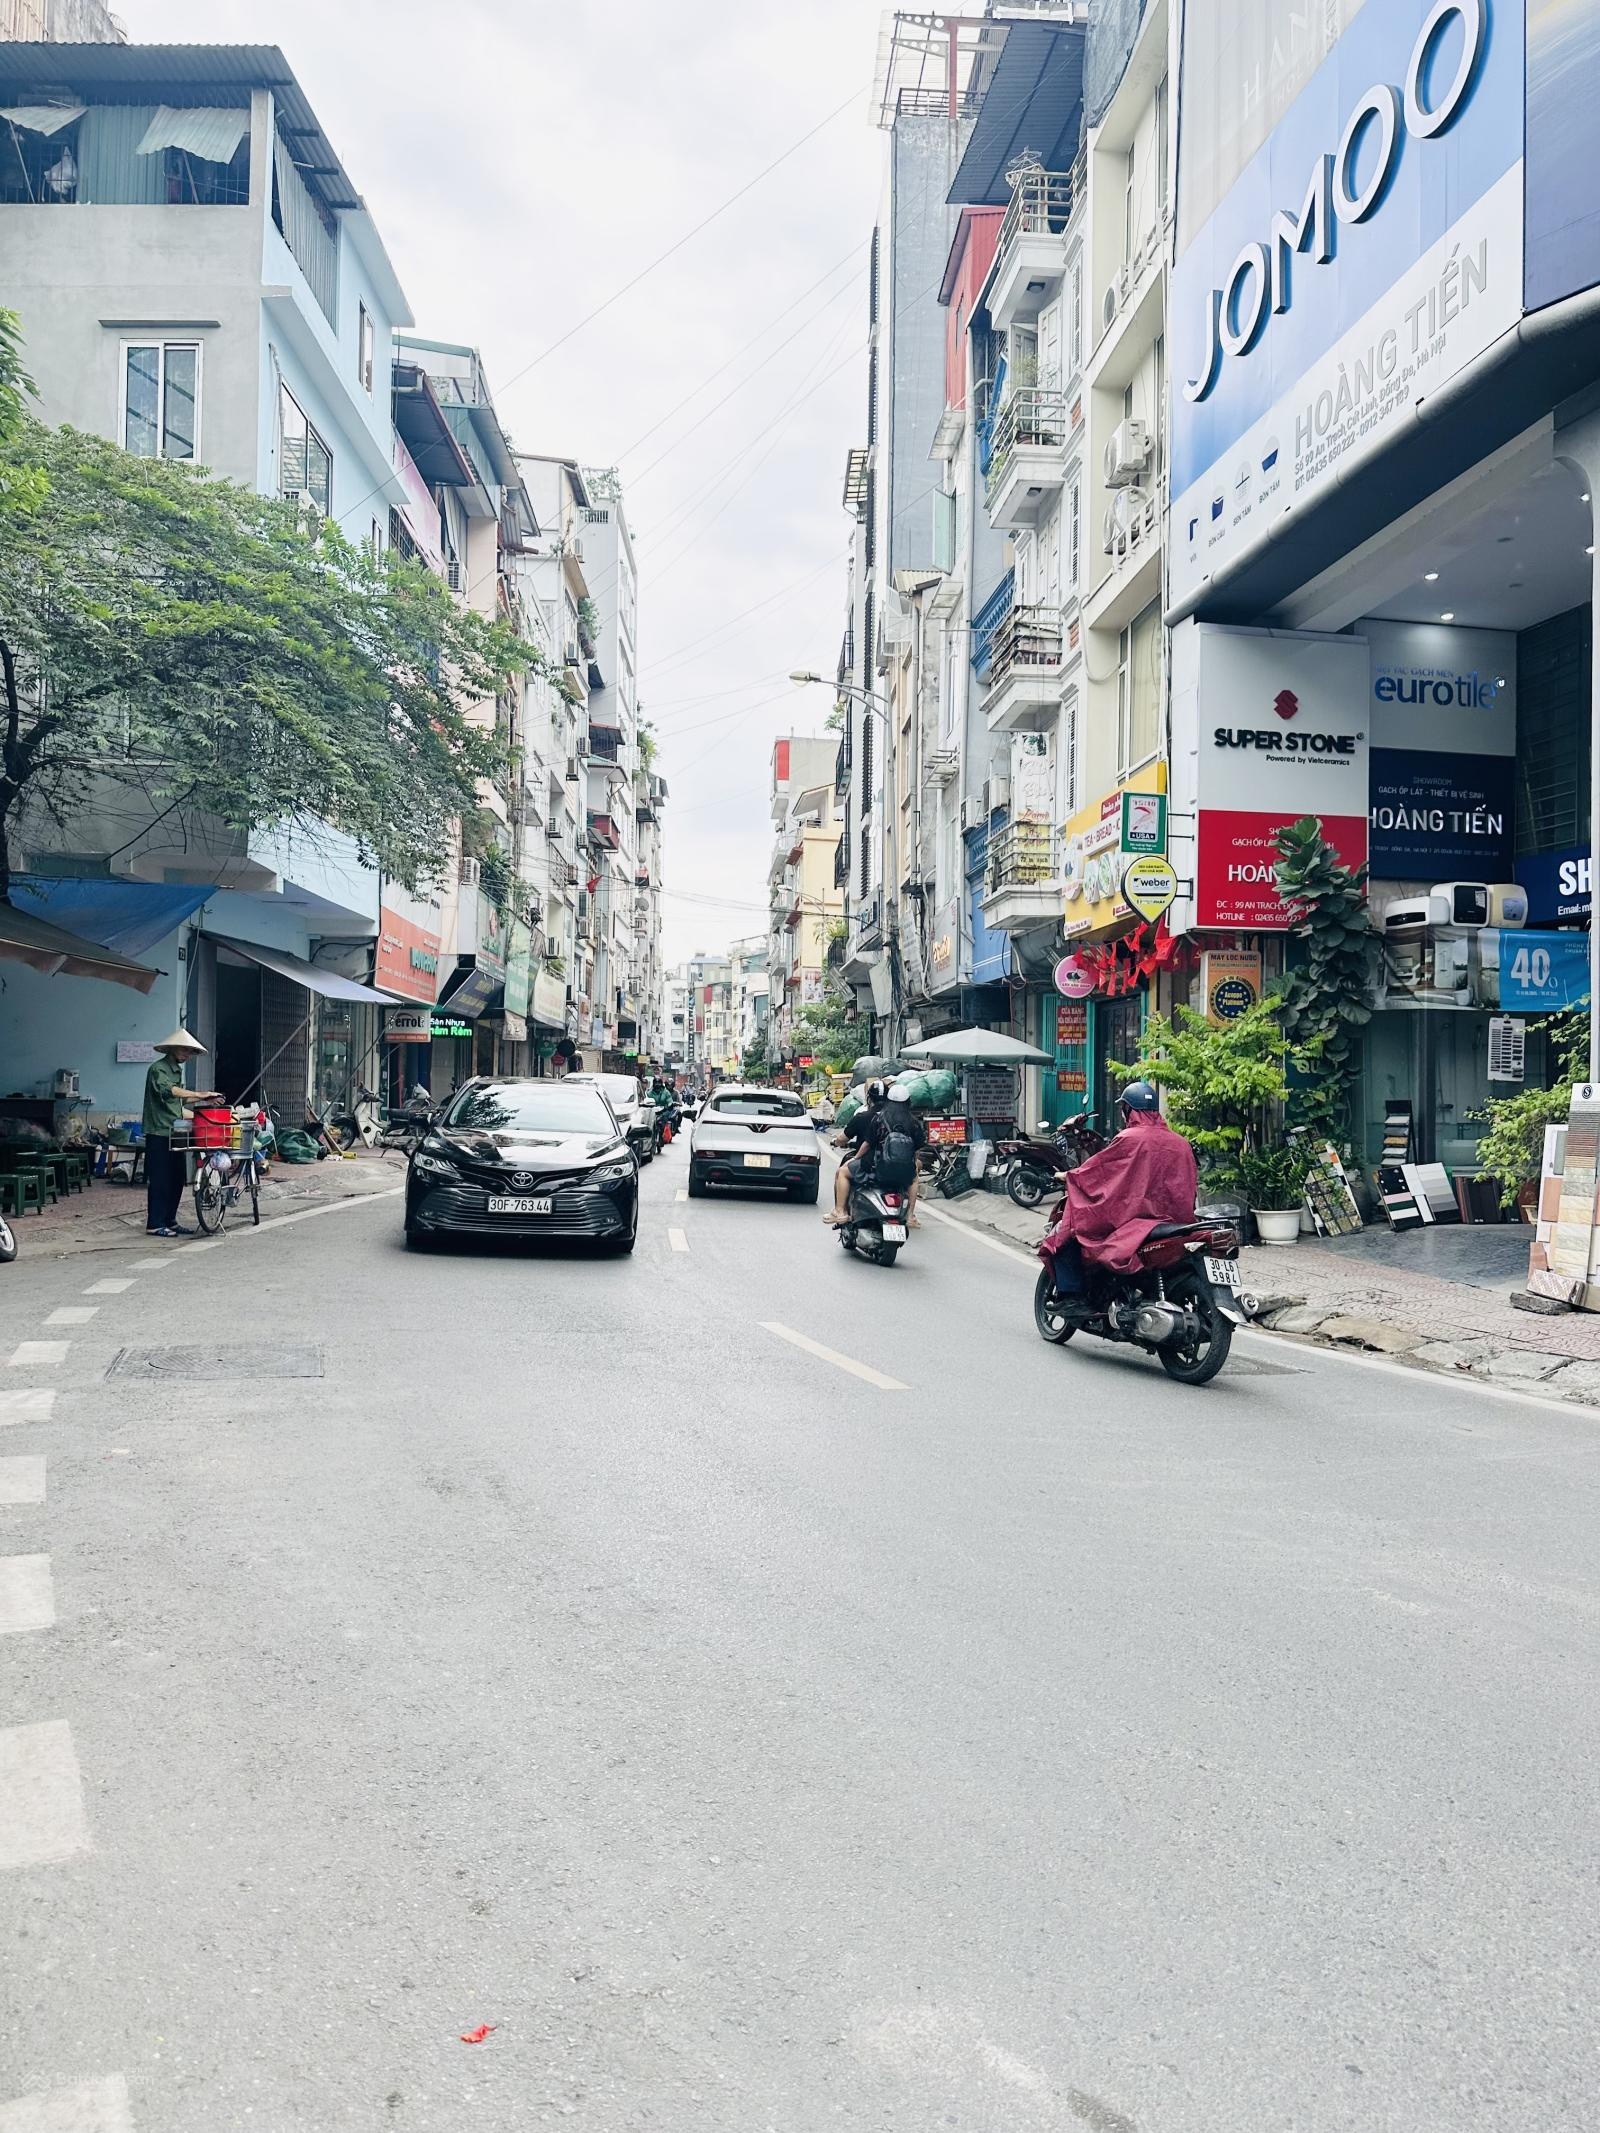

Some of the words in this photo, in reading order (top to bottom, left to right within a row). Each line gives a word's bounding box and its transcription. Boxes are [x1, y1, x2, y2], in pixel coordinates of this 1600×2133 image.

[1182, 0, 1487, 403] JOMOO
[1296, 328, 1397, 458] HOÀNG
[1404, 238, 1487, 354] TIẾN
[1305, 450, 1314, 467] 99
[1374, 671, 1496, 709] eurotile
[1266, 754, 1296, 763] Powered
[1297, 757, 1306, 765] by
[1308, 757, 1350, 766] Vietceramics
[1413, 776, 1452, 786] SHOWROOM
[1449, 804, 1503, 835] TIẾN
[1135, 832, 1151, 840] USA
[1228, 860, 1278, 883] HOÀN
[1140, 878, 1170, 887] weber
[1235, 901, 1244, 909] 99
[1245, 901, 1255, 909] AN
[1557, 903, 1581, 916] Email:
[1216, 912, 1246, 921] HOTLINE
[1255, 913, 1275, 922] 02435
[1275, 914, 1288, 922] 650
[1222, 998, 1245, 1006] Platinum
[491, 1199, 549, 1211] 30F-763.44
